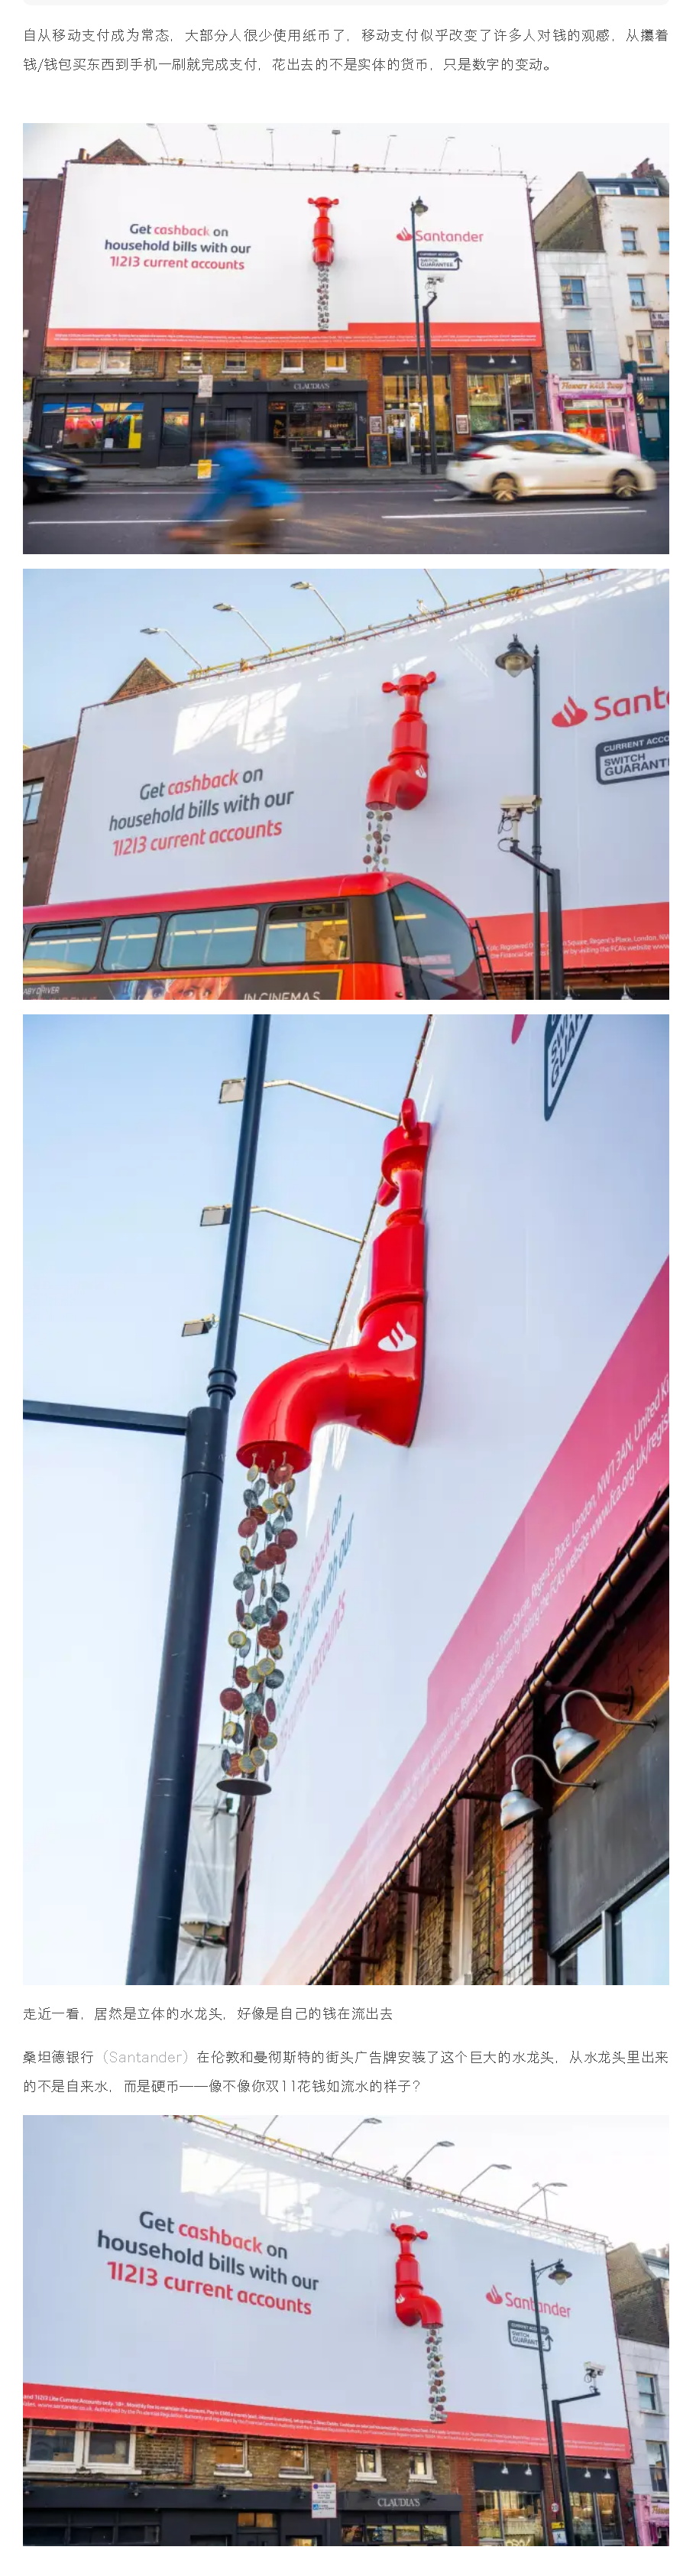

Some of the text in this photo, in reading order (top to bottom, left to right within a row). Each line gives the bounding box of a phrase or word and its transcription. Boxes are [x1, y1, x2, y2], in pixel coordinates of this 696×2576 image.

[129, 223, 228, 237] Get cashback on
[415, 230, 484, 242] Santander
[105, 239, 251, 254] household bills with our
[144, 258, 189, 268] current
[191, 260, 244, 271] accounts
[594, 686, 669, 721] Sant
[604, 739, 644, 752] CURRENT
[604, 753, 646, 767] SWITCH
[604, 758, 669, 777] GUARANT
[139, 768, 264, 800] Get cashback on
[108, 791, 295, 831] household bills with our
[151, 829, 206, 851] current
[209, 819, 283, 844] accounts
[36, 986, 60, 994] DRIVER
[634, 1387, 660, 1442] United
[138, 2211, 288, 2260] Get cashback on
[97, 2230, 319, 2291] household bills with our
[163, 2276, 234, 2301] current
[237, 2290, 312, 2315] accounts
[505, 2292, 571, 2318] Santander
[513, 2336, 545, 2347] GUARANTE
[377, 2498, 420, 2507] CLAUDIA'S
